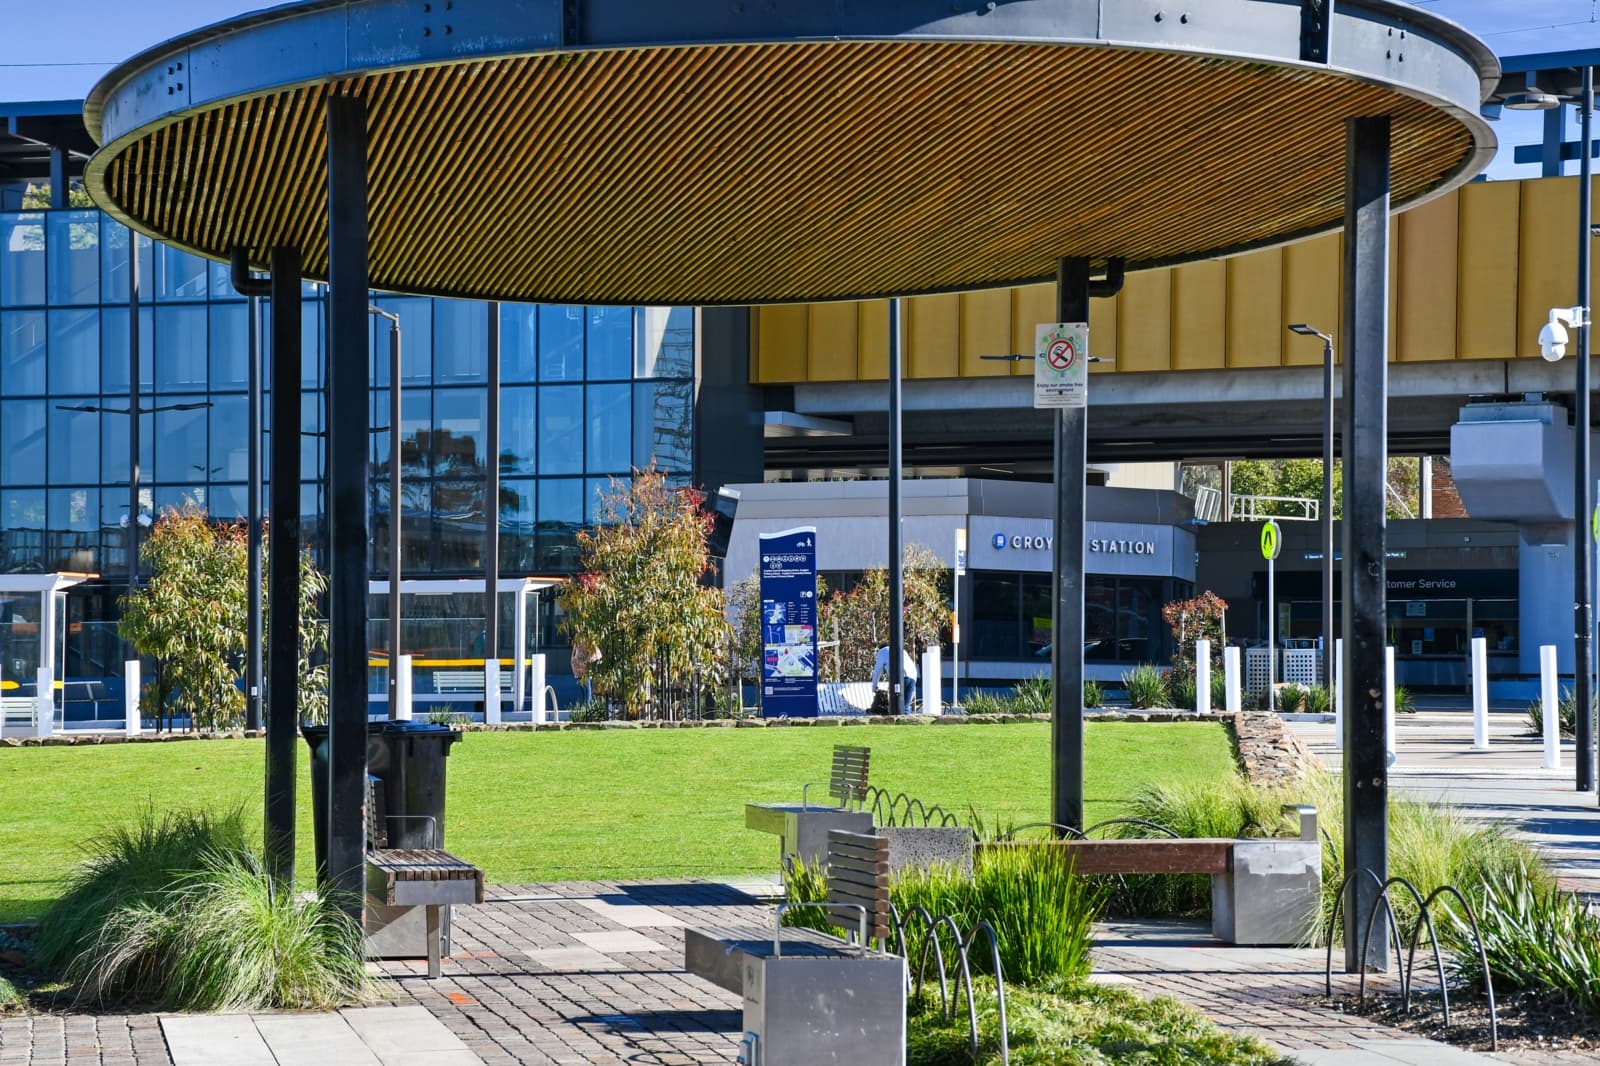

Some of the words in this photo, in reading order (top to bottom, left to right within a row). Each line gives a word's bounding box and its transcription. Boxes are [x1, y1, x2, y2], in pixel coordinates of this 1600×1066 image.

[1012, 535, 1054, 549] CROY
[1091, 539, 1155, 554] STATION
[1387, 580, 1417, 589] tomer
[1418, 579, 1457, 589] Service
